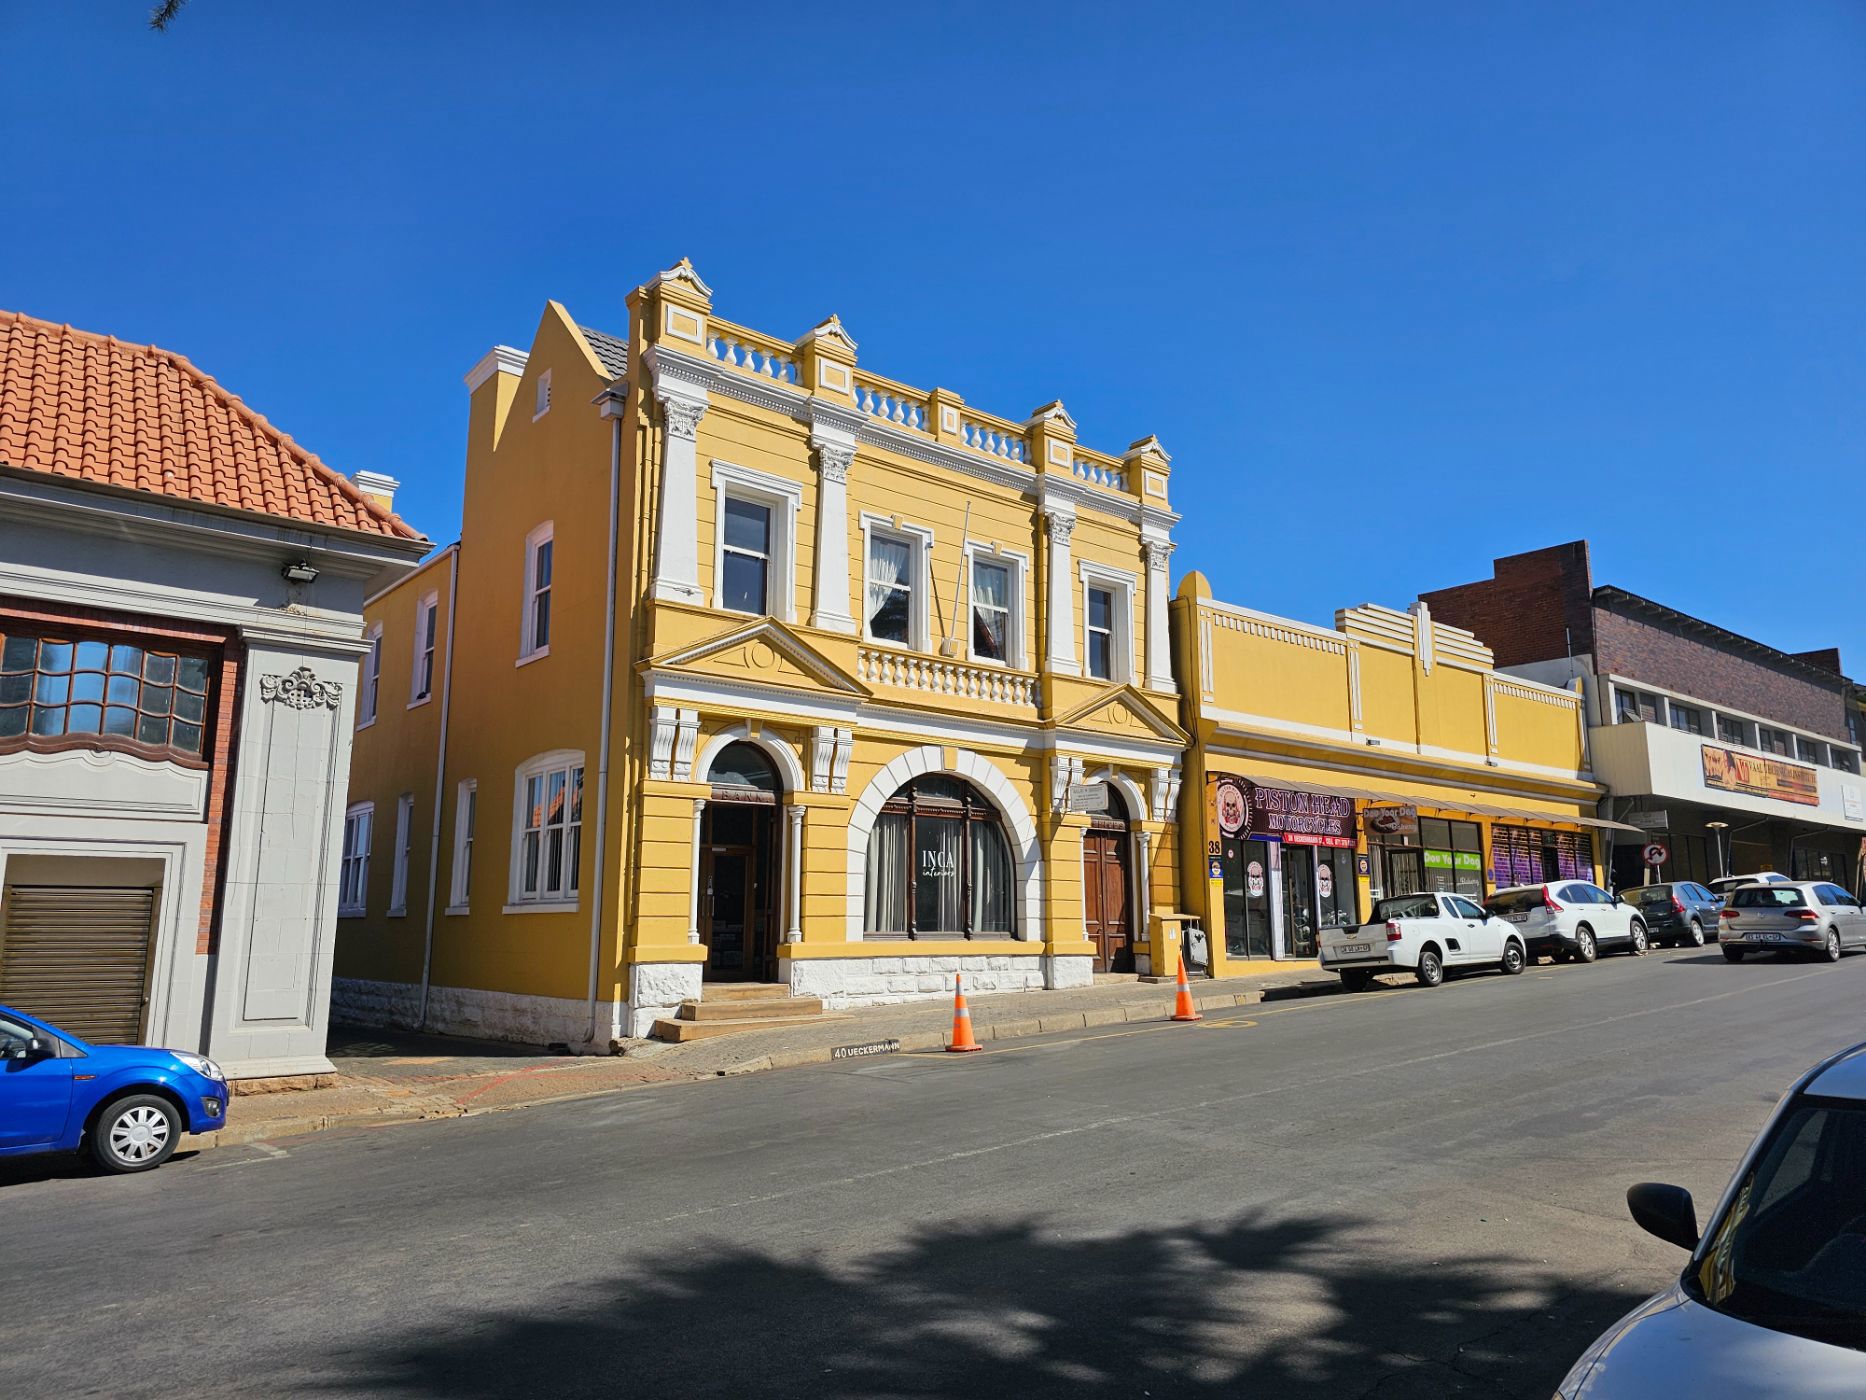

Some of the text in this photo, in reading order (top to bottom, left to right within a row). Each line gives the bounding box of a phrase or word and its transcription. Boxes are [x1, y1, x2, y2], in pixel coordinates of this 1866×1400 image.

[1255, 787, 1351, 818] PISTON HEAD
[1268, 813, 1342, 835] MOTORCYCLES
[1208, 840, 1221, 855] 38
[922, 850, 955, 868] INCA
[834, 1042, 900, 1059] 40 UECKERMANN
